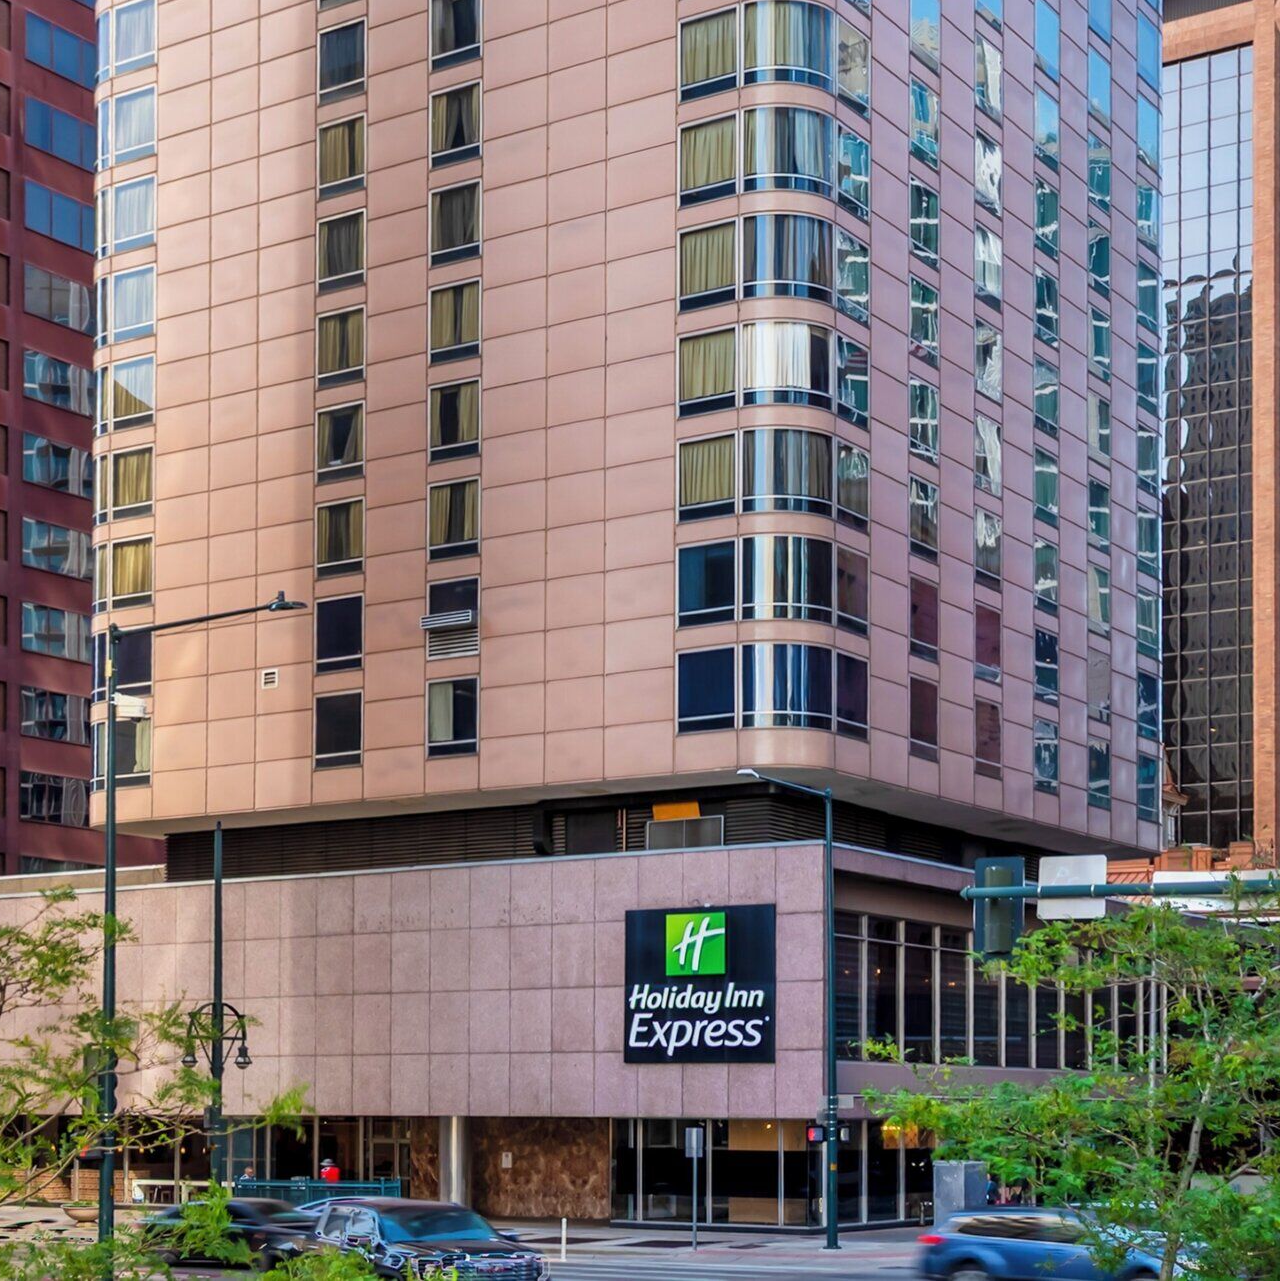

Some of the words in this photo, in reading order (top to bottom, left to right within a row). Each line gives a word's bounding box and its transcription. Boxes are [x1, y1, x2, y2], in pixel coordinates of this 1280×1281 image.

[628, 983, 722, 1015] Holiday
[723, 981, 765, 1009] Inn
[628, 1012, 764, 1057] Express
